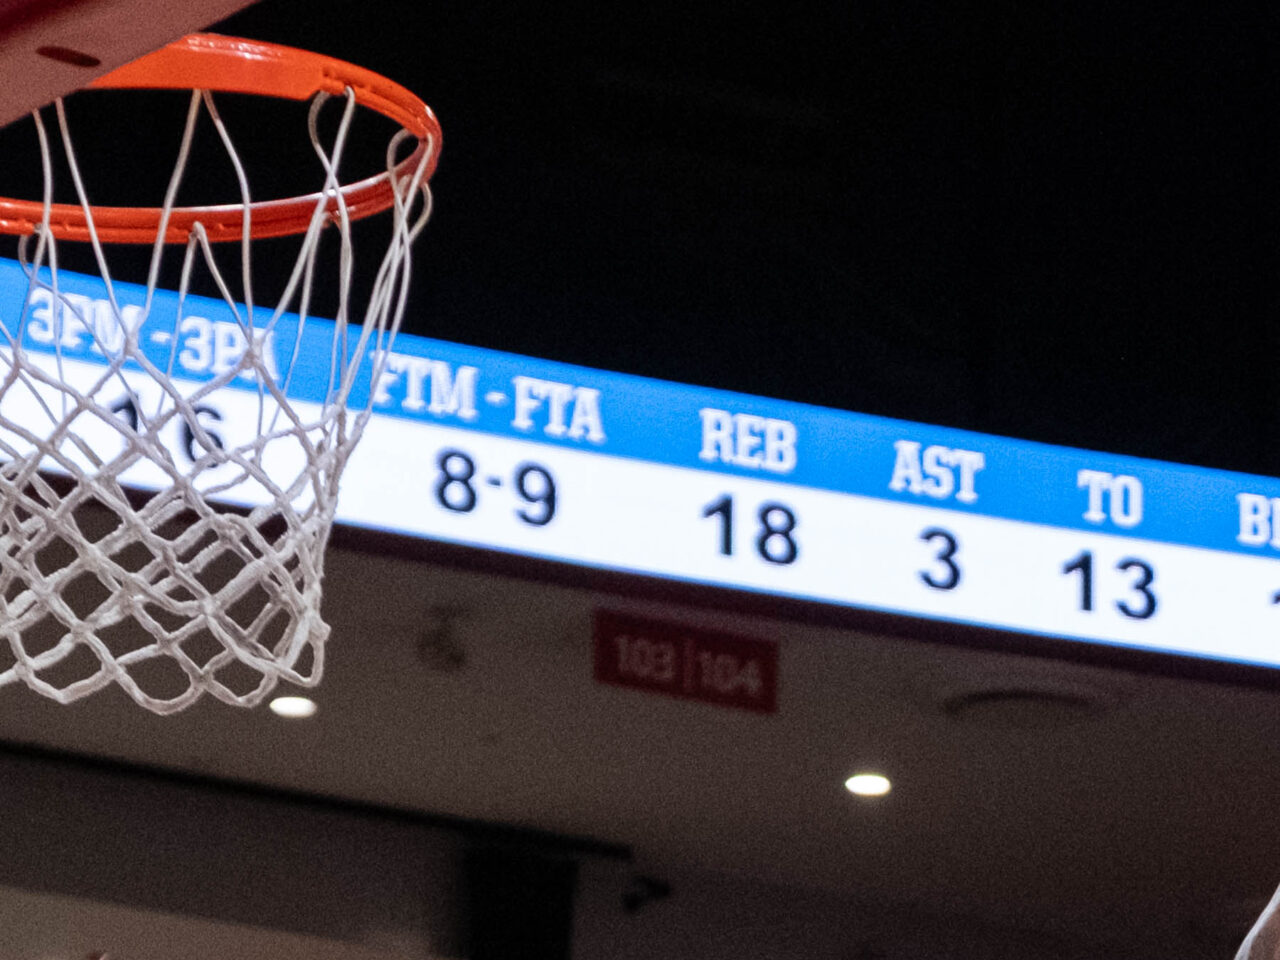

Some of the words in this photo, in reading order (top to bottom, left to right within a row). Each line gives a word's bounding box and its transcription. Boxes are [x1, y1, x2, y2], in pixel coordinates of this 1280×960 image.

[436, 450, 556, 526] 8-9
[702, 494, 798, 566] 18
[919, 525, 962, 590] 3
[1063, 551, 1158, 620] 13
[699, 408, 798, 473] REB
[889, 440, 986, 503] AST
[1077, 469, 1144, 527] TO
